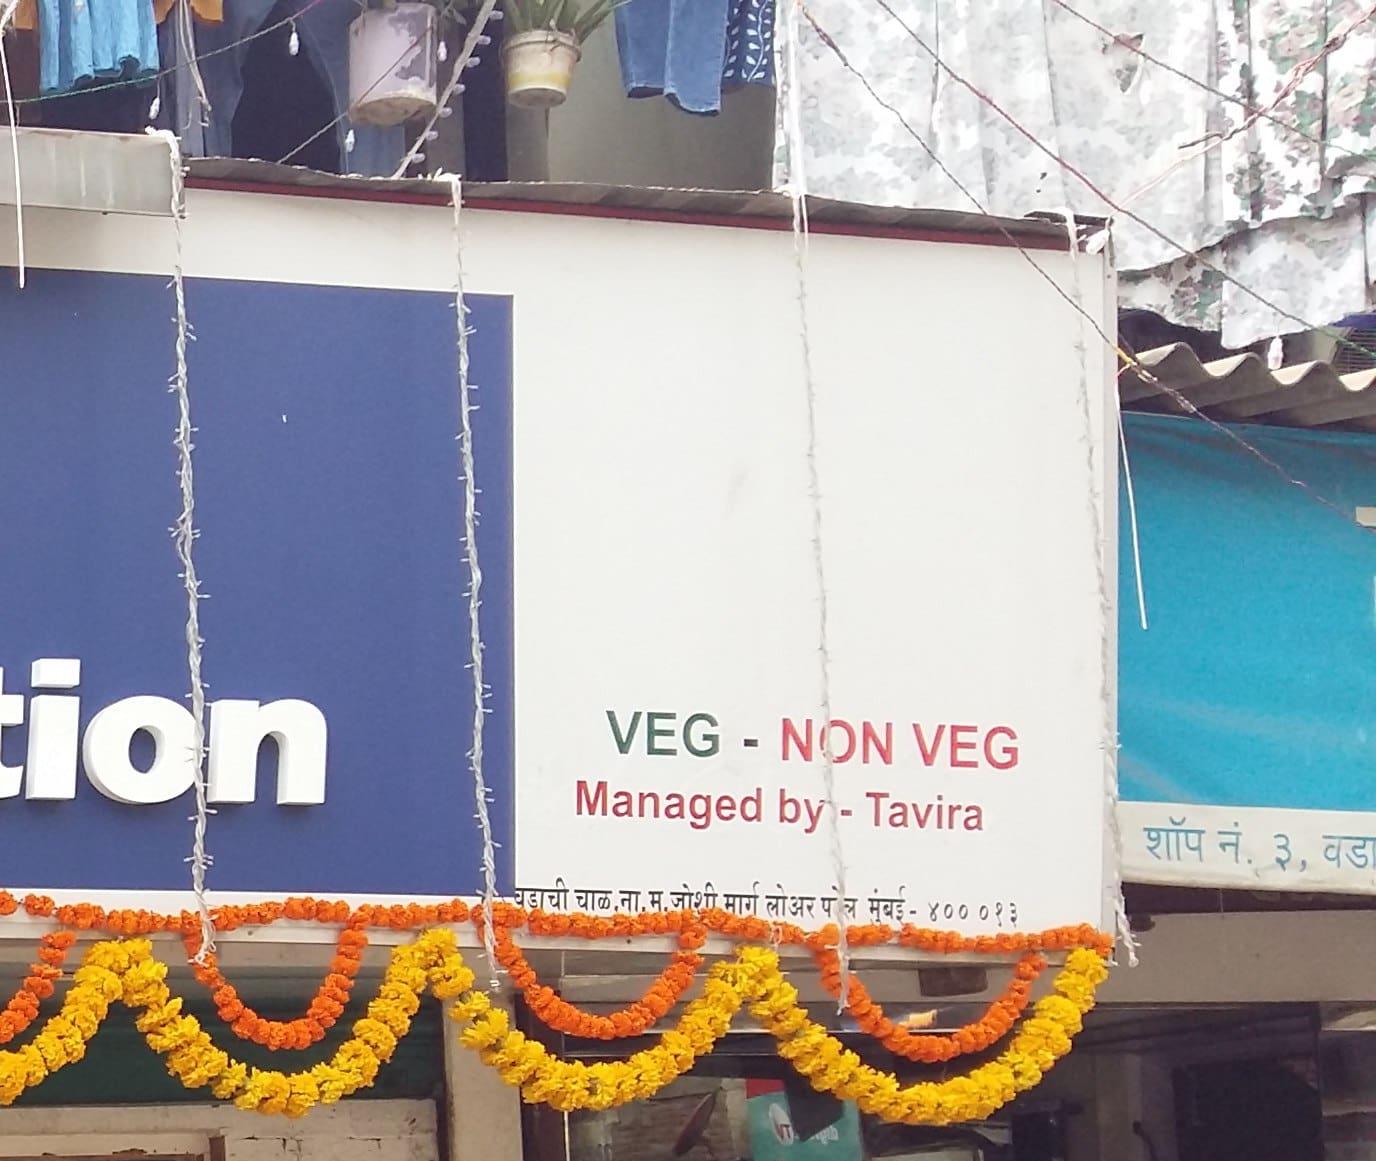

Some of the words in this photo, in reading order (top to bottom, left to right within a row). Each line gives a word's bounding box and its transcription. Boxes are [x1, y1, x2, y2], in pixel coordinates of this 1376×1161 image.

[606, 710, 720, 757] VEG
[781, 718, 893, 765] NON
[912, 723, 1018, 769] VEG
[576, 780, 762, 829] Managed
[778, 788, 826, 833] by
[865, 792, 983, 831] Tavira
[1143, 816, 1205, 862] शॉप
